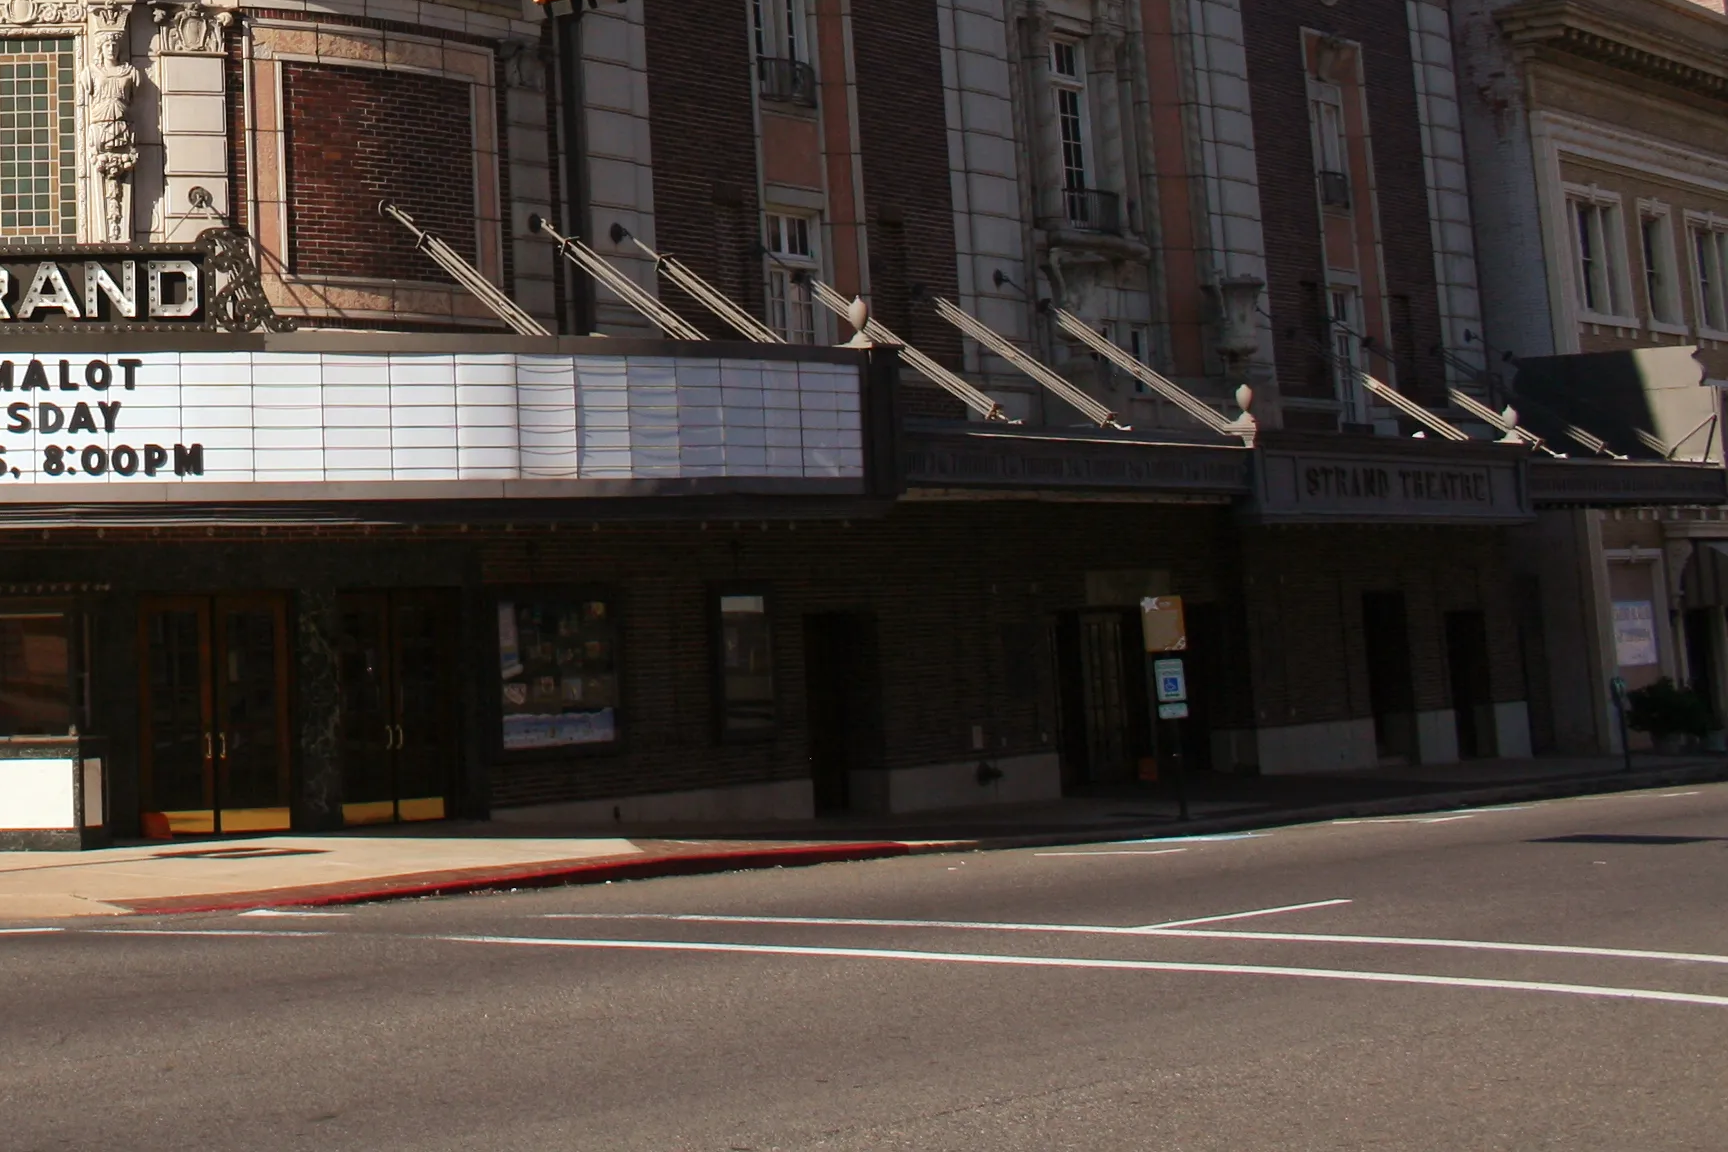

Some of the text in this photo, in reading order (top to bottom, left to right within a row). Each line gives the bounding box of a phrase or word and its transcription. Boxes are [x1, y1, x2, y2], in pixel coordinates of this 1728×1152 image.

[42, 443, 204, 477] 8:00PM
[1306, 466, 1485, 502] STRAND THEATRE
